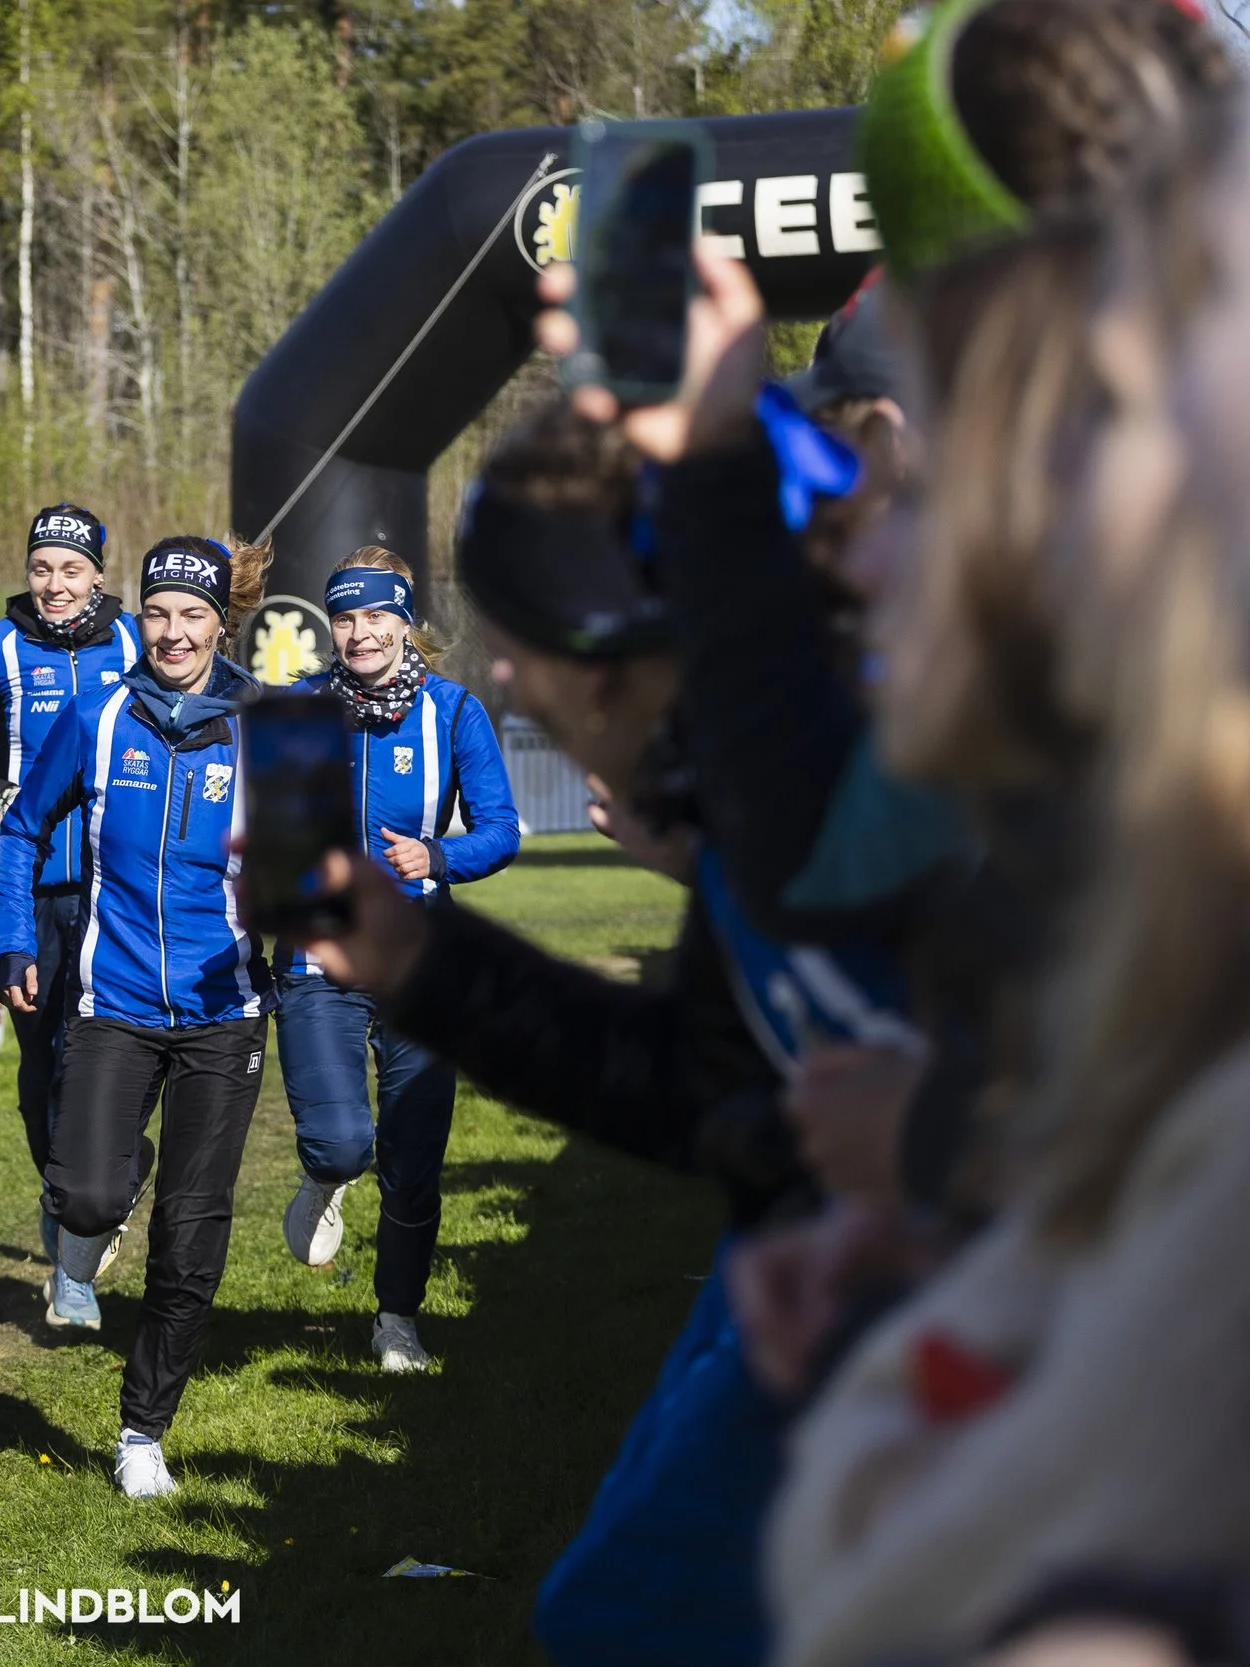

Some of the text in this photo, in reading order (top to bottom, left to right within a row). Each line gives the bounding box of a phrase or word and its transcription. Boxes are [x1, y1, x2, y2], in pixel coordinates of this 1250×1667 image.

[34, 516, 91, 541] LEDX
[39, 530, 86, 544] LIGHTS
[147, 554, 219, 585] LEDX
[154, 570, 211, 588] LIGHTS
[330, 581, 365, 594] Göteborg
[122, 766, 149, 776] RYGGAR
[123, 760, 149, 769] SKATÅS
[112, 778, 158, 791] noname
